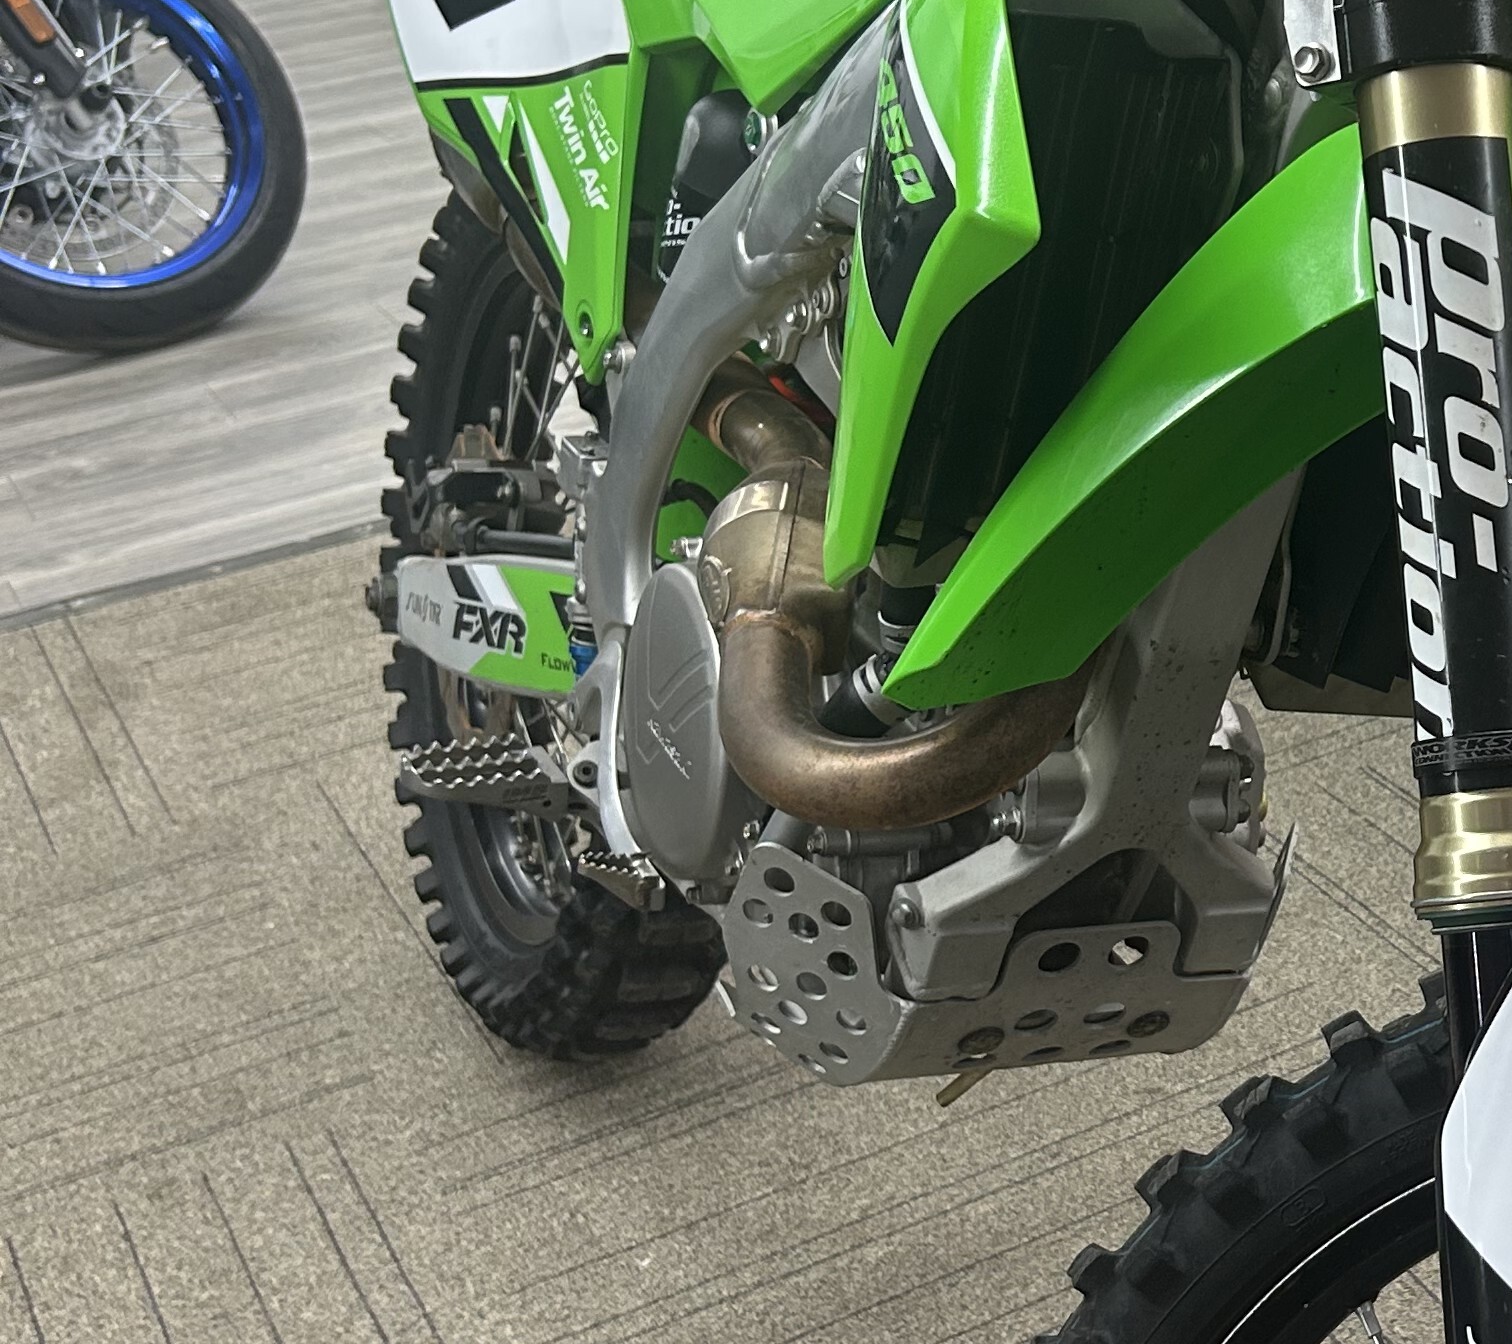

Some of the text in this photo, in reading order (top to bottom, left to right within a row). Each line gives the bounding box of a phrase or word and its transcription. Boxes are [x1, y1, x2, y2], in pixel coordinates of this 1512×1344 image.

[553, 85, 587, 165] Twin
[579, 168, 610, 210] Air
[879, 57, 936, 204] 450
[1382, 166, 1511, 576] pro-
[453, 600, 527, 655] FXR
